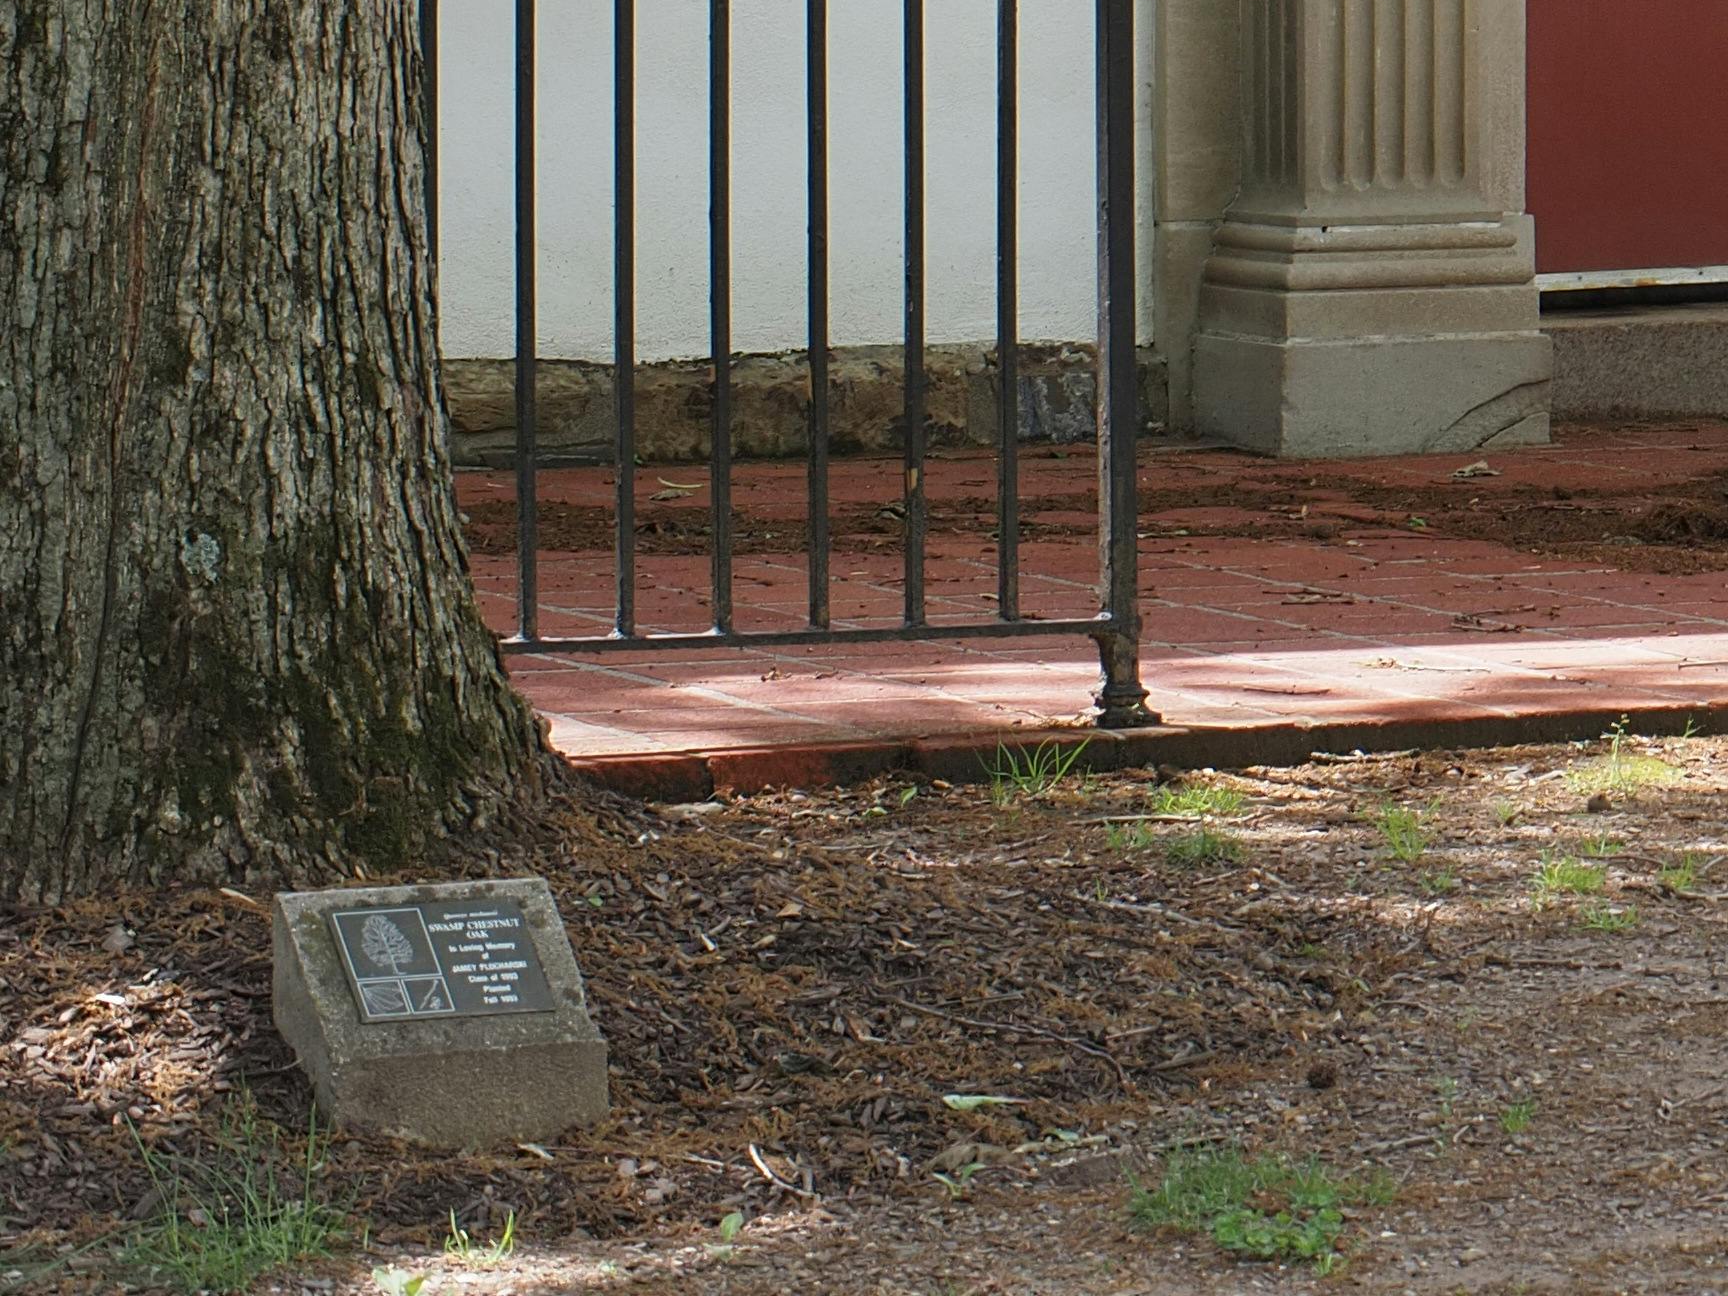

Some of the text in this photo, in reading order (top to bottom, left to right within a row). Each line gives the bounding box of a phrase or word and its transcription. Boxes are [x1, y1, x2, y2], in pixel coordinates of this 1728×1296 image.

[428, 918, 519, 933] SWAMP CHESTNUT
[466, 930, 489, 939] OAK
